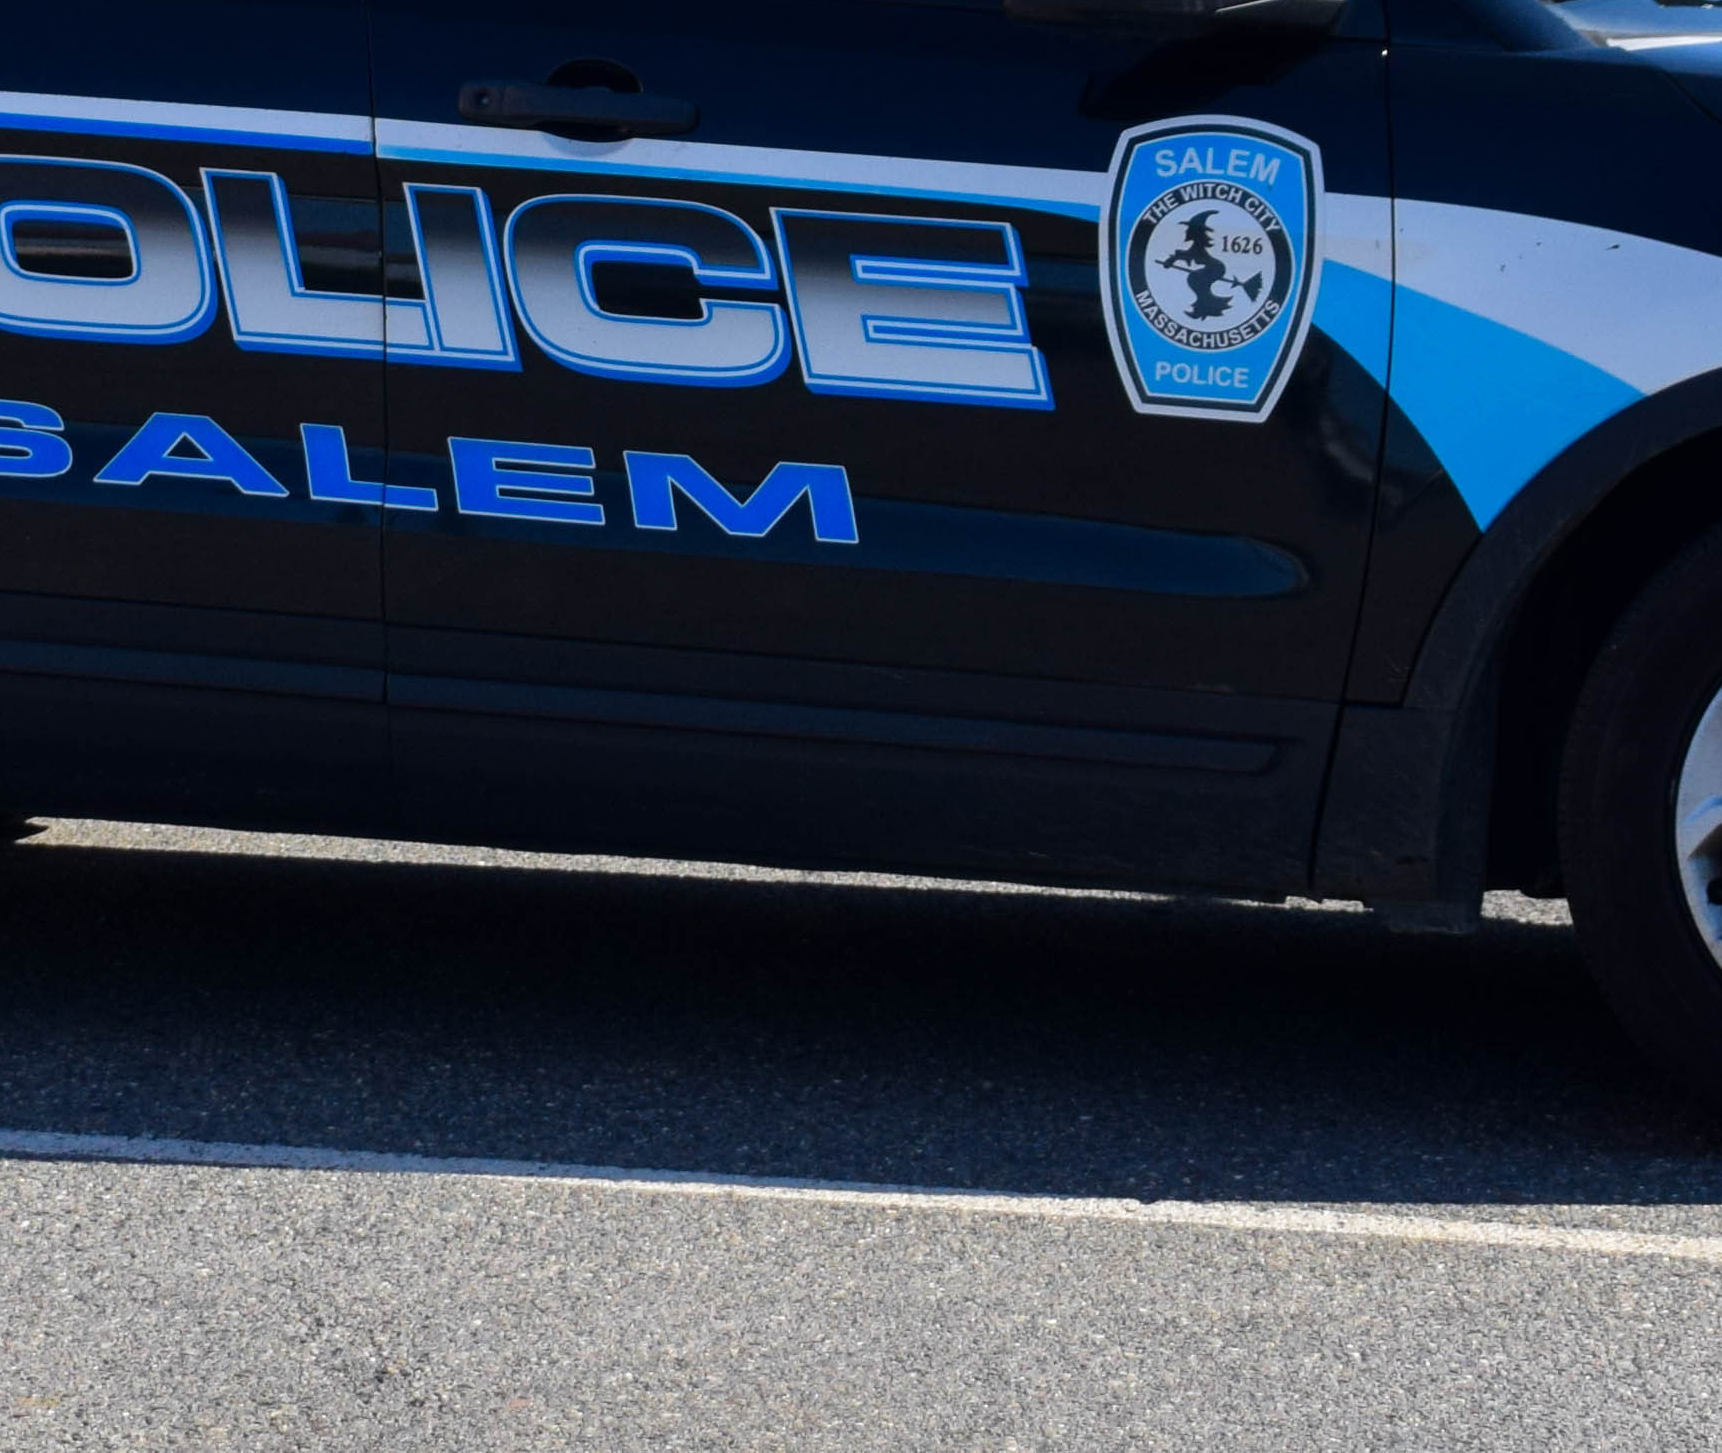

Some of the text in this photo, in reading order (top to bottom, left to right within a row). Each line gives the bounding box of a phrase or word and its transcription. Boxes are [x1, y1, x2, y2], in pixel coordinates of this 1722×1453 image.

[1154, 147, 1282, 185] SALEM
[1143, 182, 1282, 232] THE WITCH CITY
[1221, 234, 1263, 255] 1626
[1134, 289, 1282, 350] MASSACHUSETTS
[1154, 360, 1250, 389] POLICE
